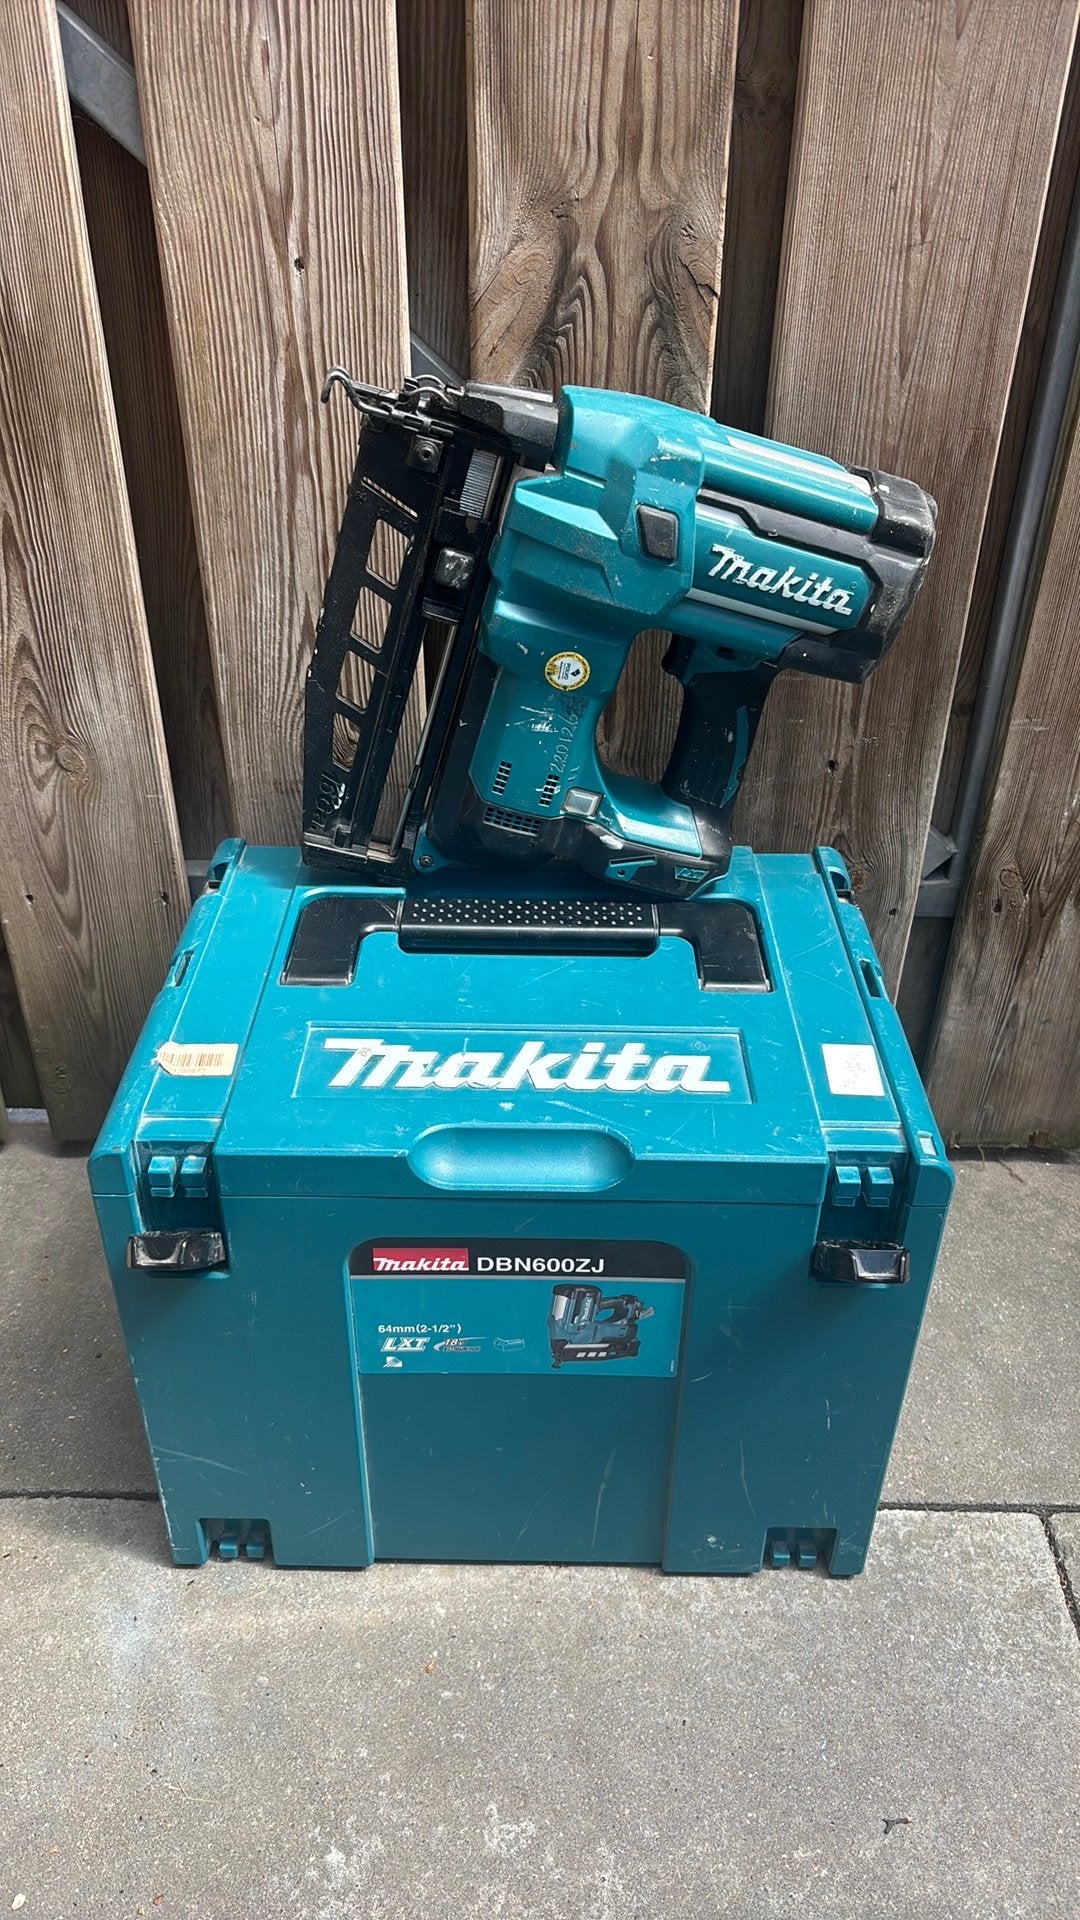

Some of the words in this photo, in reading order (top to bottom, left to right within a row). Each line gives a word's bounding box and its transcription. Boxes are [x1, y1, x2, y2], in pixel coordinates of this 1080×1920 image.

[708, 543, 854, 615] Makita
[550, 713, 579, 774] 220126
[323, 1037, 731, 1094] Makita
[373, 1257, 469, 1271] Makita
[477, 1256, 604, 1273] DBN600ZJ
[381, 1337, 431, 1352] LXT
